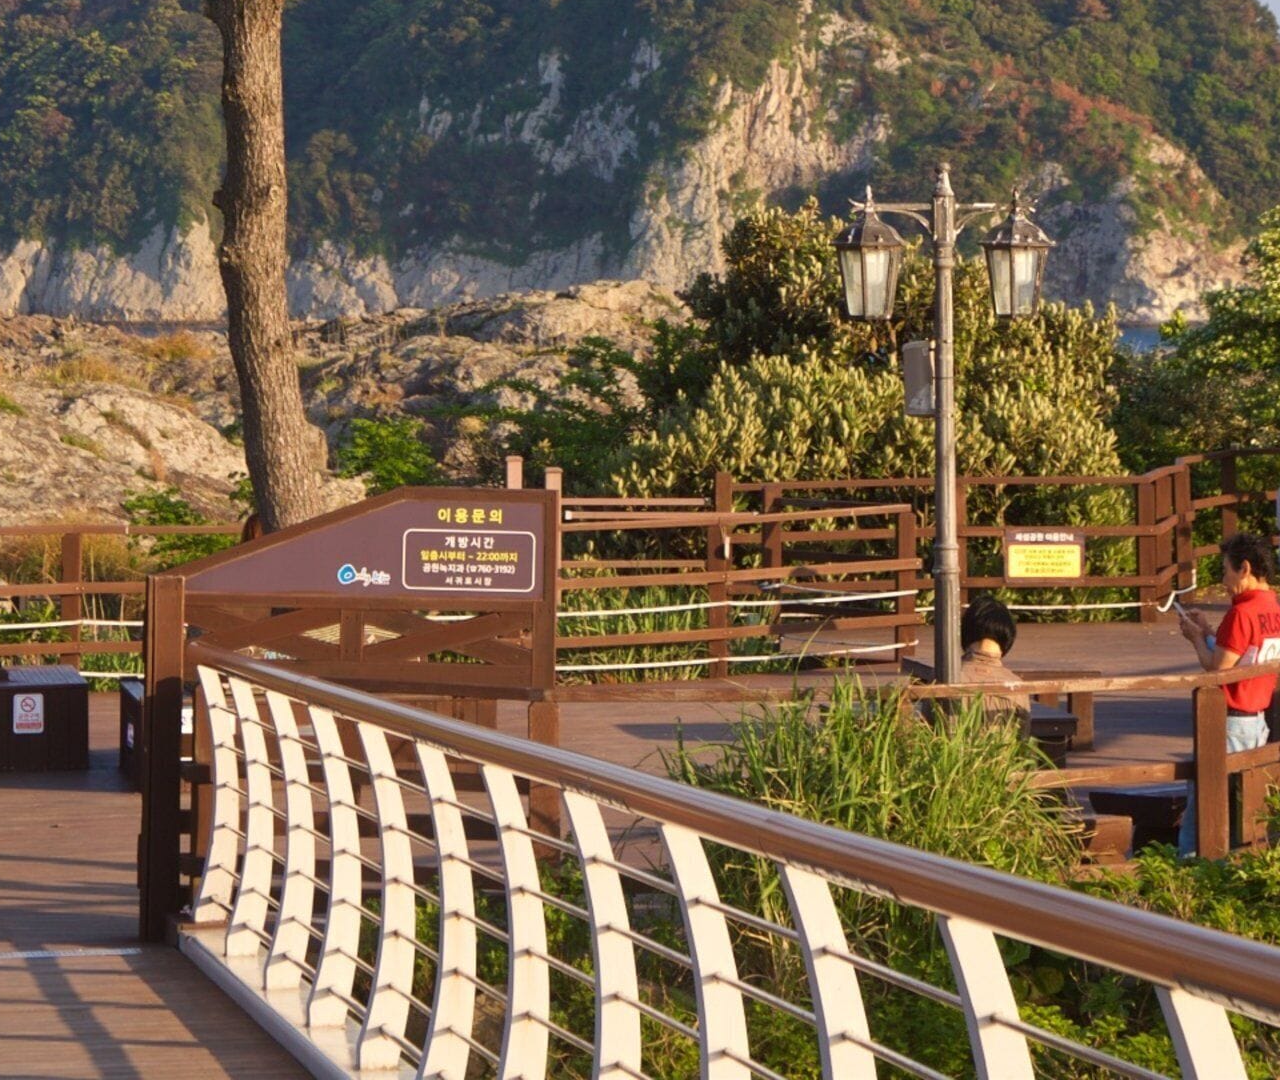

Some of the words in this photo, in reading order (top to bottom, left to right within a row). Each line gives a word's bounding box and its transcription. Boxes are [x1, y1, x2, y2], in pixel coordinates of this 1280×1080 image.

[437, 508, 503, 524] 이용문의
[445, 536, 495, 549] 개방시간
[420, 550, 466, 561] 일출시부터
[476, 552, 518, 563] 22:00까지
[422, 562, 465, 573] 공원녹지과
